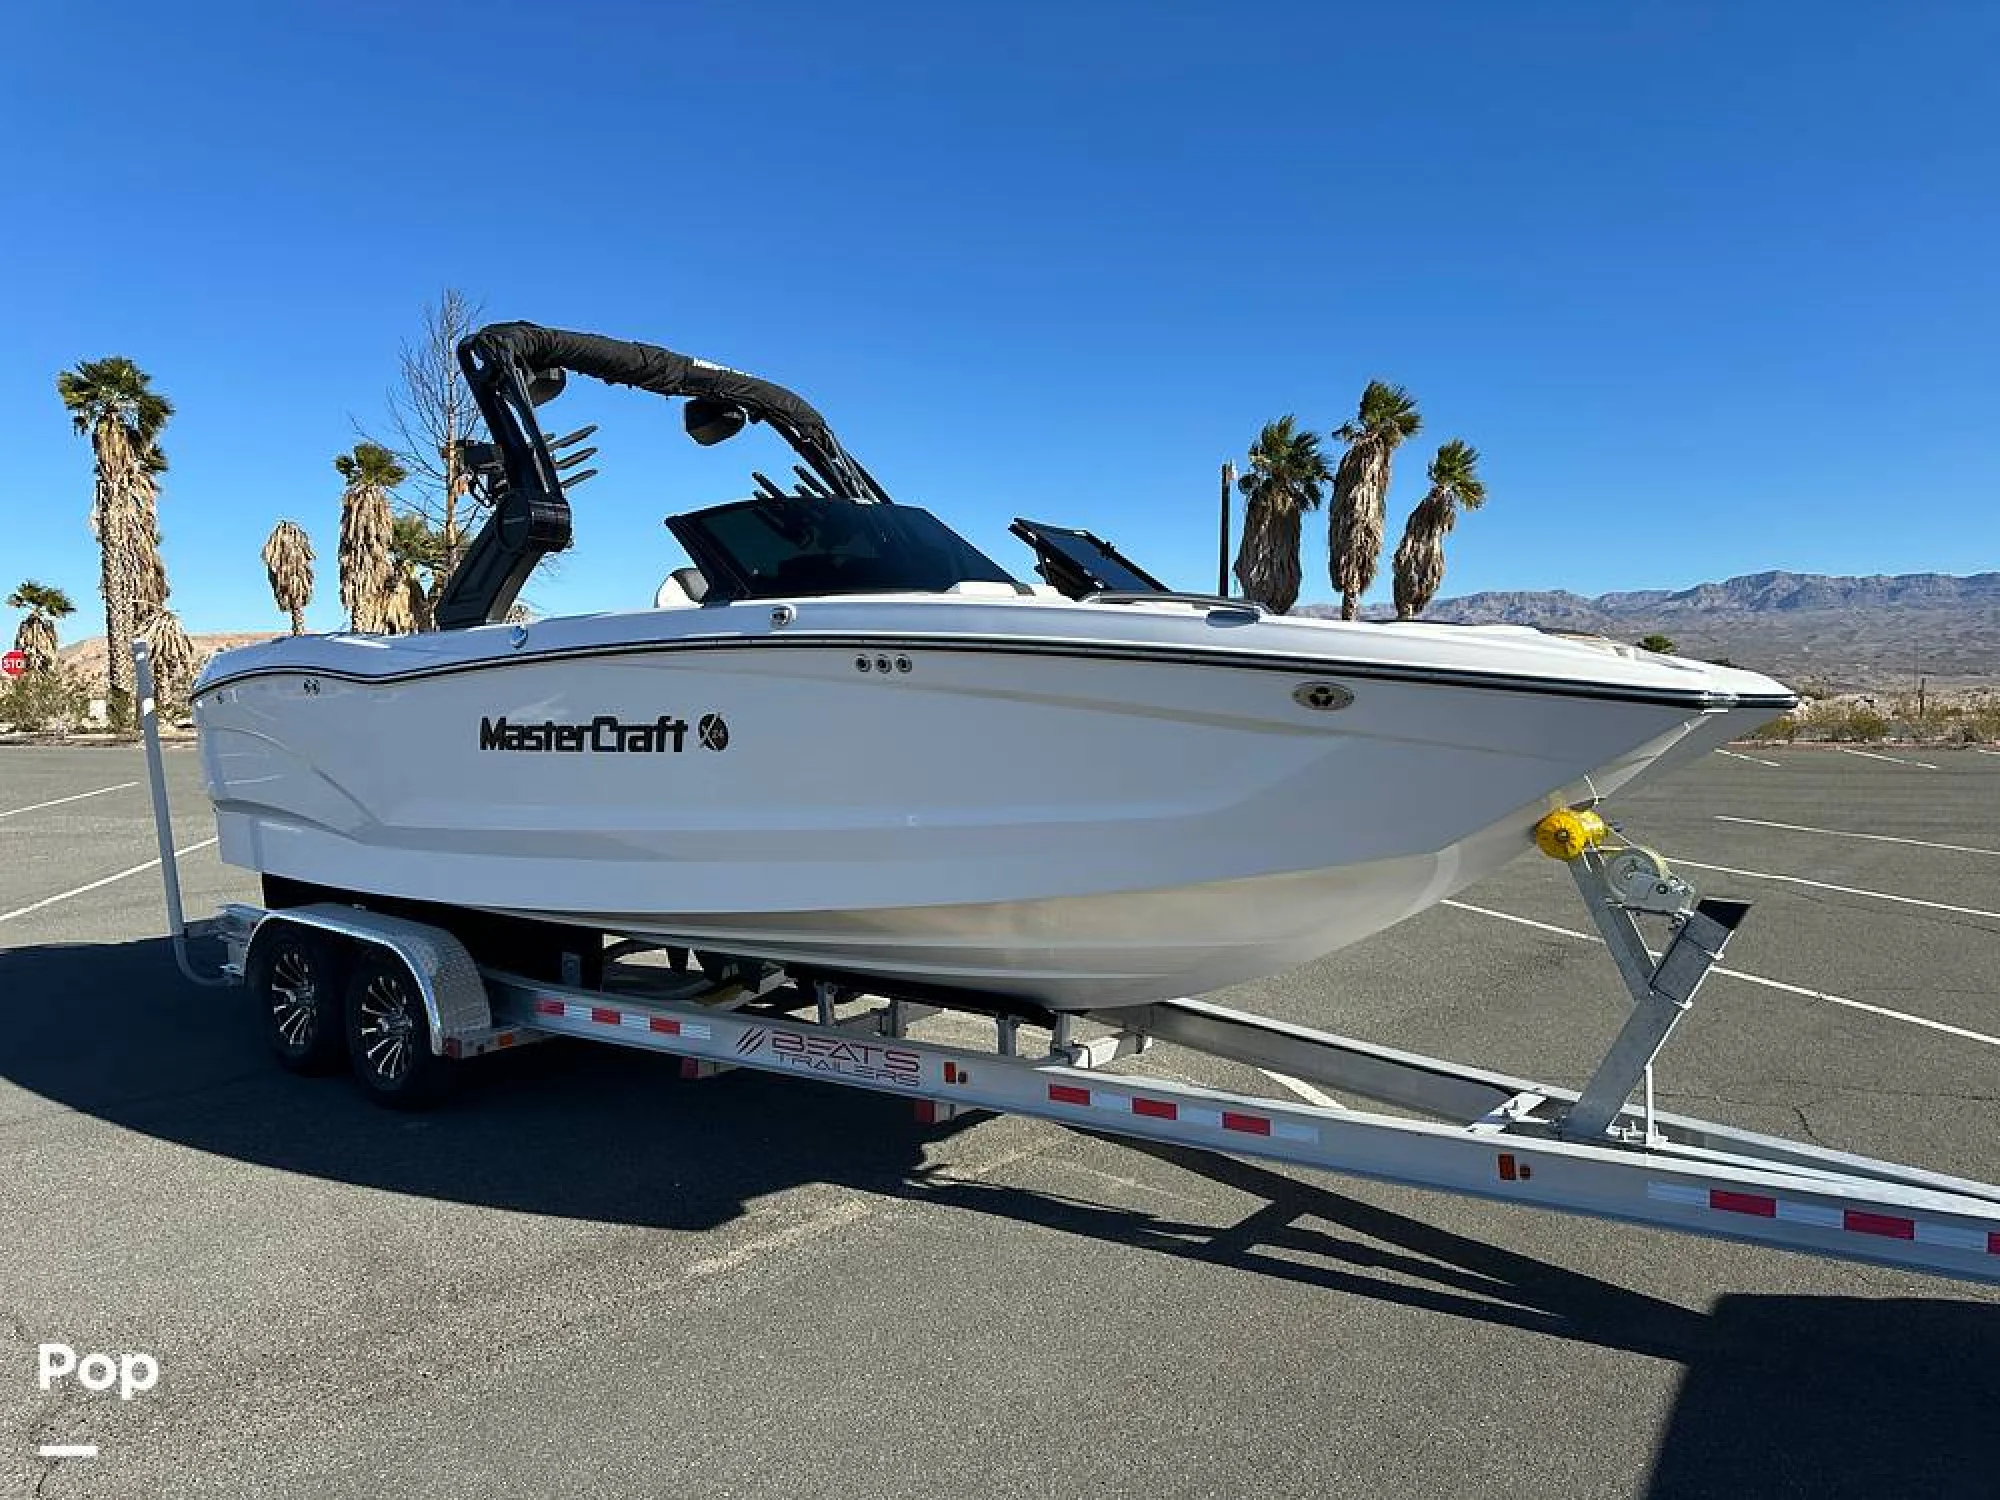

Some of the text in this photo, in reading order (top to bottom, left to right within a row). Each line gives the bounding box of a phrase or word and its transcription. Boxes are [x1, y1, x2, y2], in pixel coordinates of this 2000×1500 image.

[480, 716, 688, 752] MasterCraft
[773, 1030, 921, 1073] BEATS
[776, 1051, 921, 1087] TRAILERS
